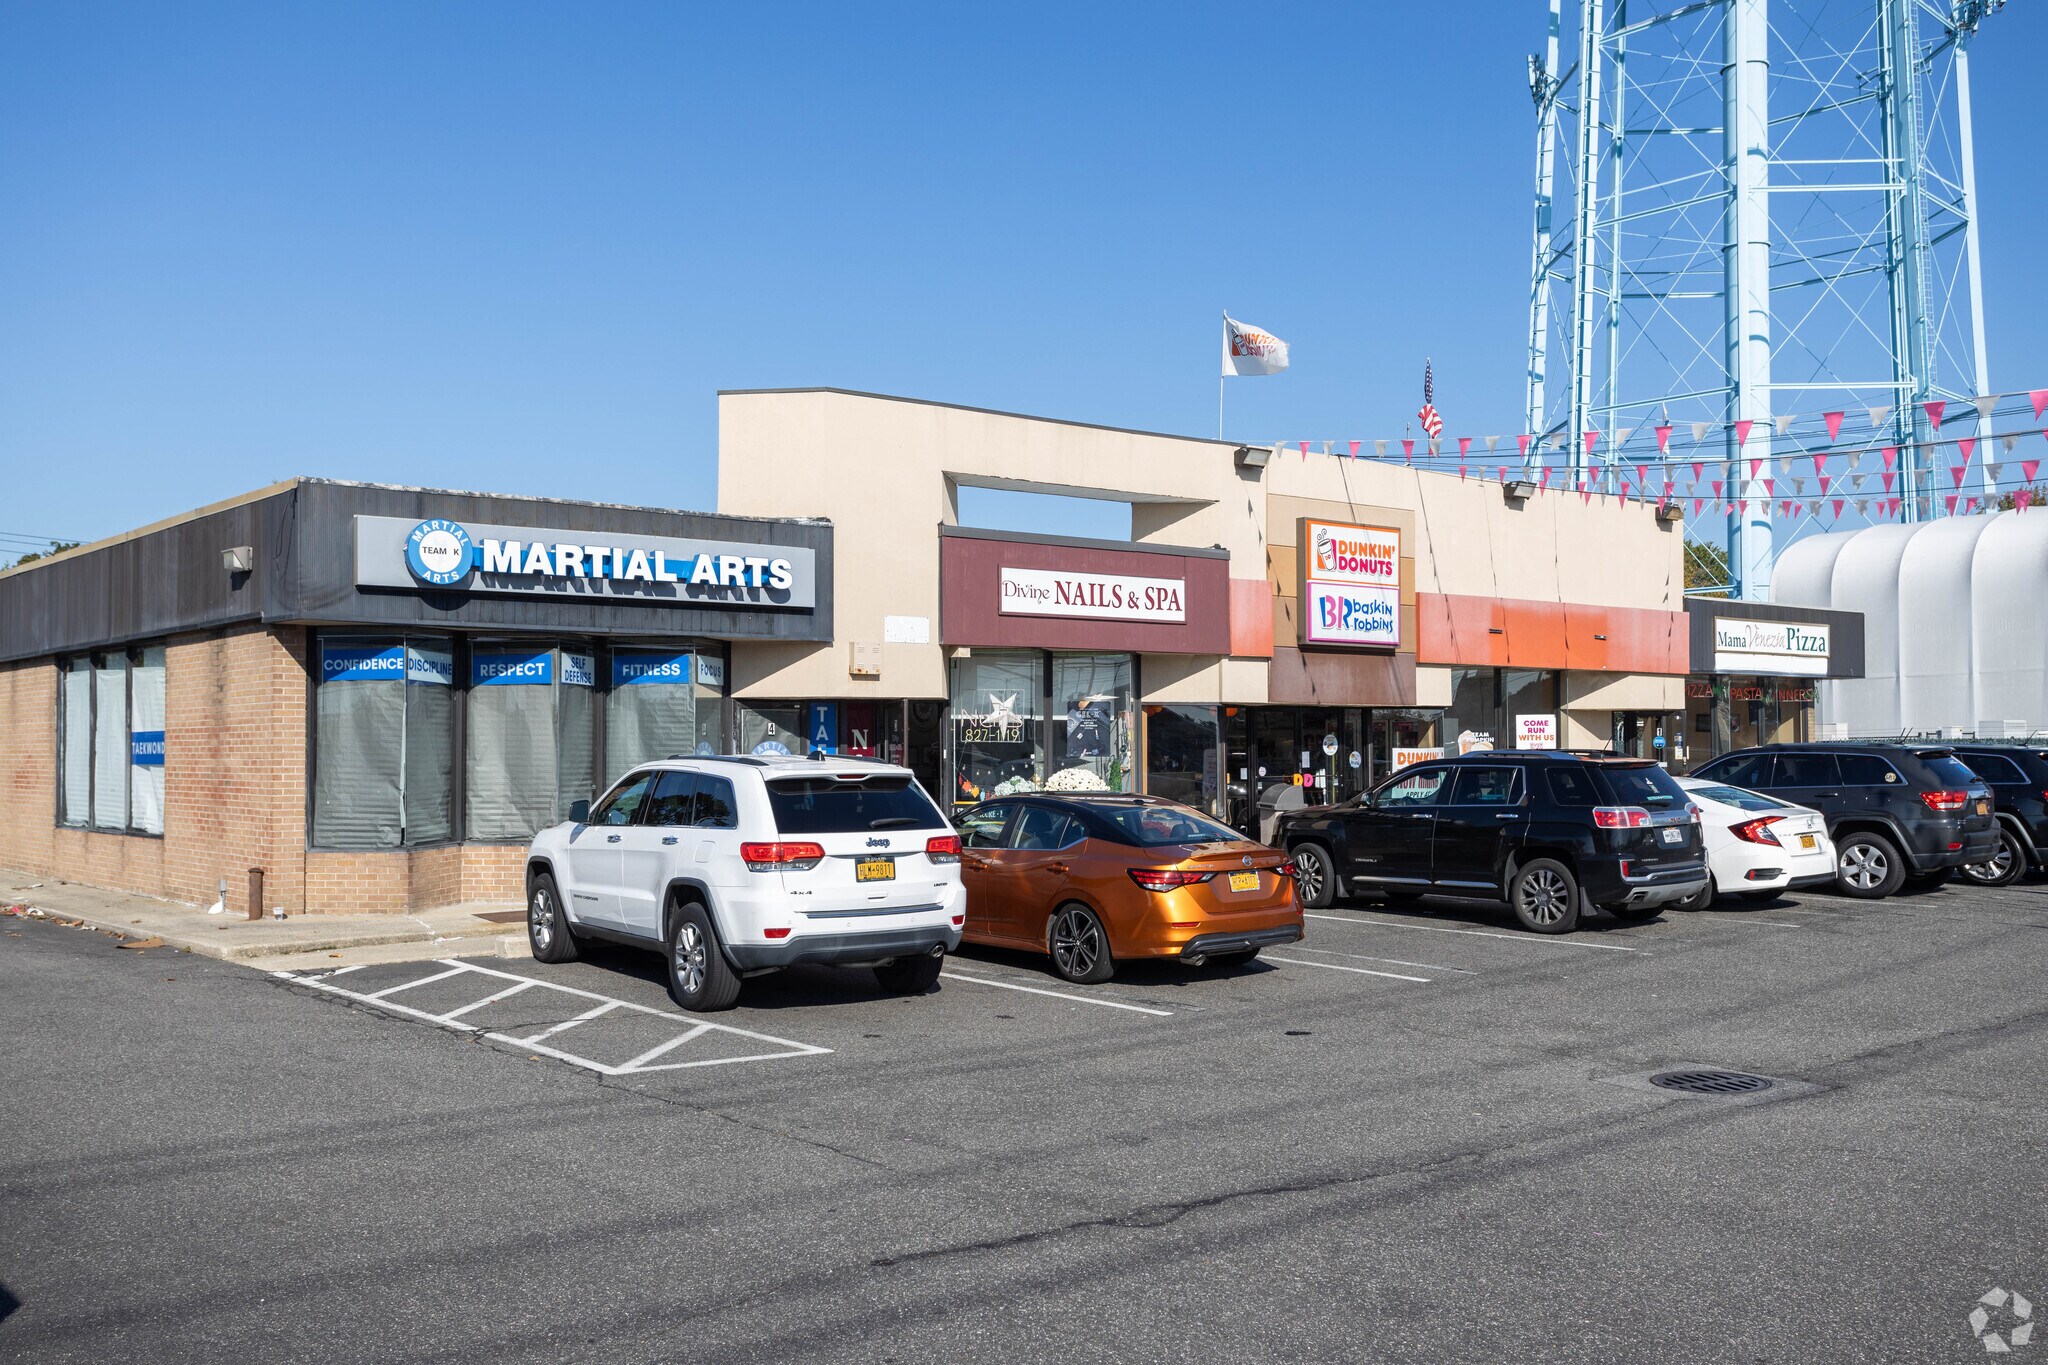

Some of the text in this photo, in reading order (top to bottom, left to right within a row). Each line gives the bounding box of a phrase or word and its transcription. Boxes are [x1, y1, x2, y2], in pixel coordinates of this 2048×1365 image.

[411, 520, 469, 547] MARTIAL
[422, 546, 460, 556] TEAM K
[1338, 540, 1395, 560] DUNKIN'
[483, 538, 793, 590] MARTIAL ARTS
[1338, 556, 1393, 576] DONUTS
[422, 570, 460, 583] ARTS
[1002, 580, 1183, 612] Divine NAILS & SPA
[1319, 595, 1353, 629] BR
[1353, 599, 1393, 616] baskin
[1353, 617, 1393, 634] robbins
[1717, 624, 1827, 653] Mama Venezia Pizza
[323, 657, 404, 672] CONFIDENCE
[408, 658, 452, 676] DISCIPLINE
[479, 662, 545, 677] RESPECT
[570, 656, 586, 669] SELF
[622, 663, 681, 677] FITNESS
[564, 670, 592, 685] DEFENSE
[700, 664, 722, 678] FOCUS
[1730, 687, 1764, 700] PASTA
[768, 723, 775, 735] 4
[965, 728, 1020, 742] 827-119
[866, 837, 891, 849] Jeep
